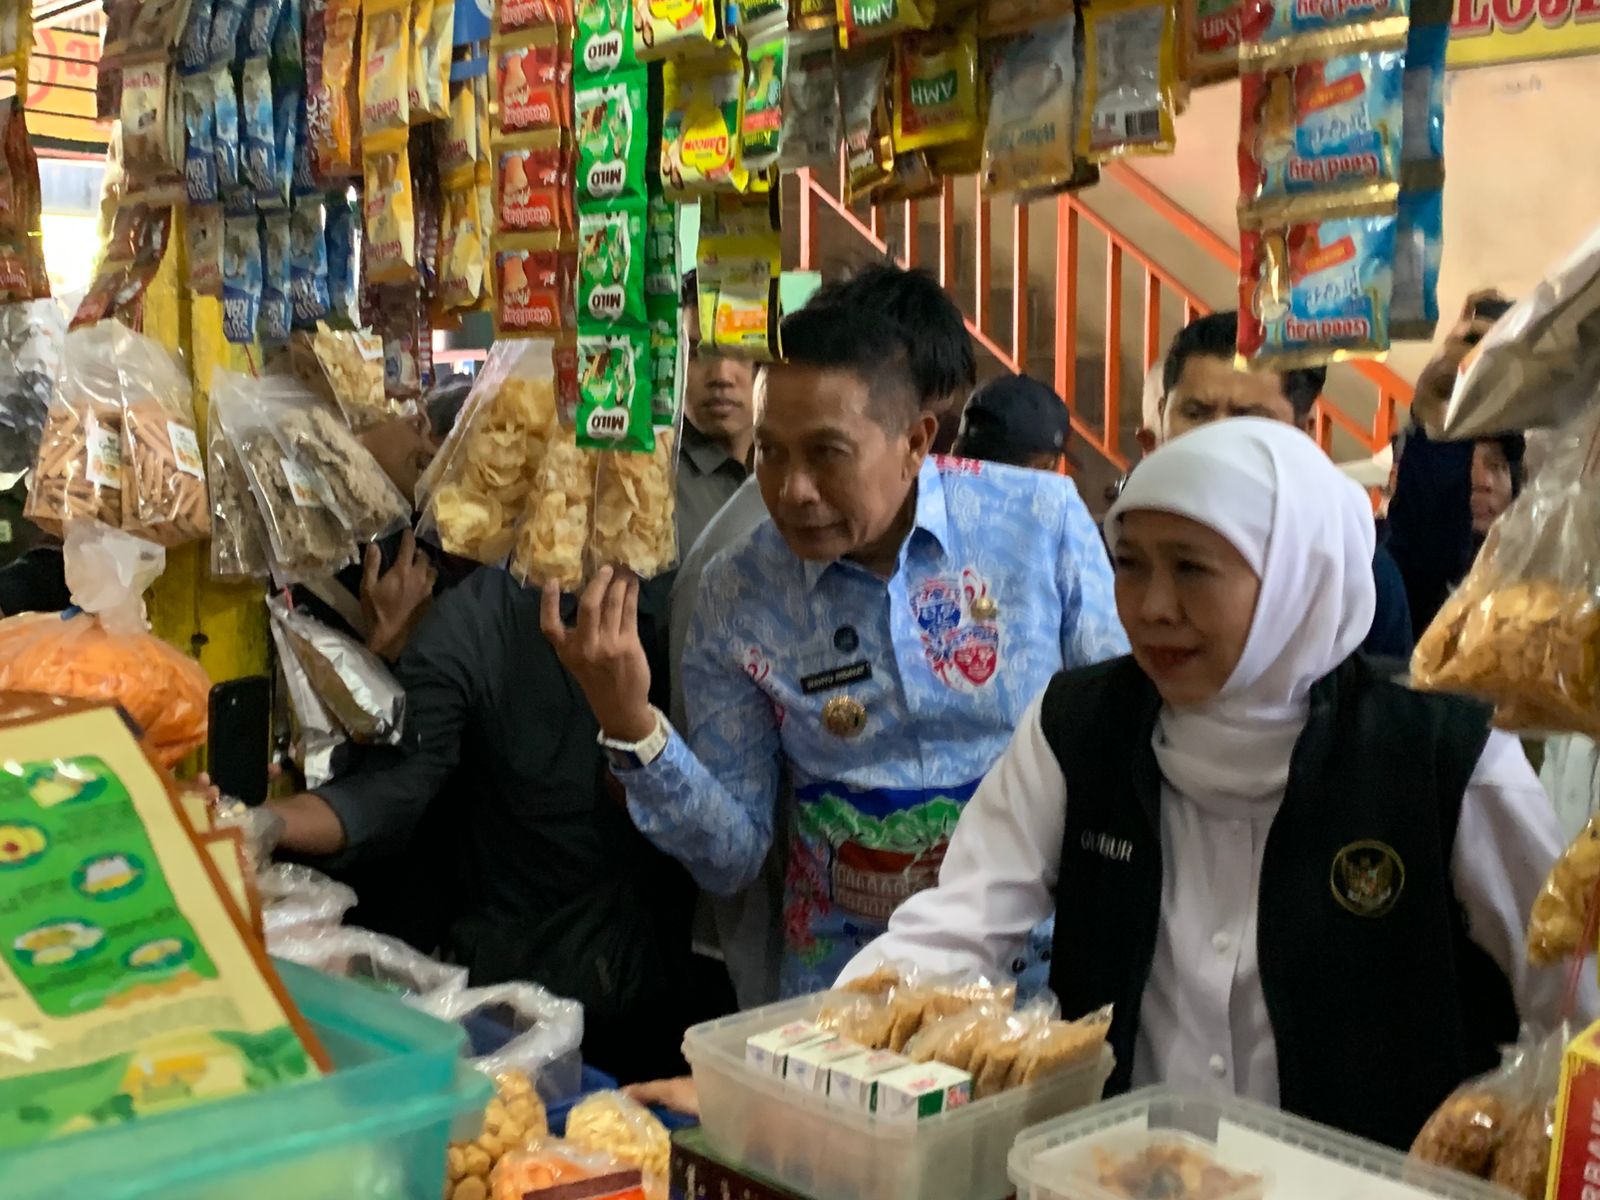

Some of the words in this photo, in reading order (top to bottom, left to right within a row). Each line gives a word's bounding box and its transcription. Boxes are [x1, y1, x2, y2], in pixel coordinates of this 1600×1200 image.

[588, 40, 619, 59] MILO
[591, 169, 622, 187] MILO
[591, 293, 622, 309] MILO
[591, 414, 624, 431] MILO
